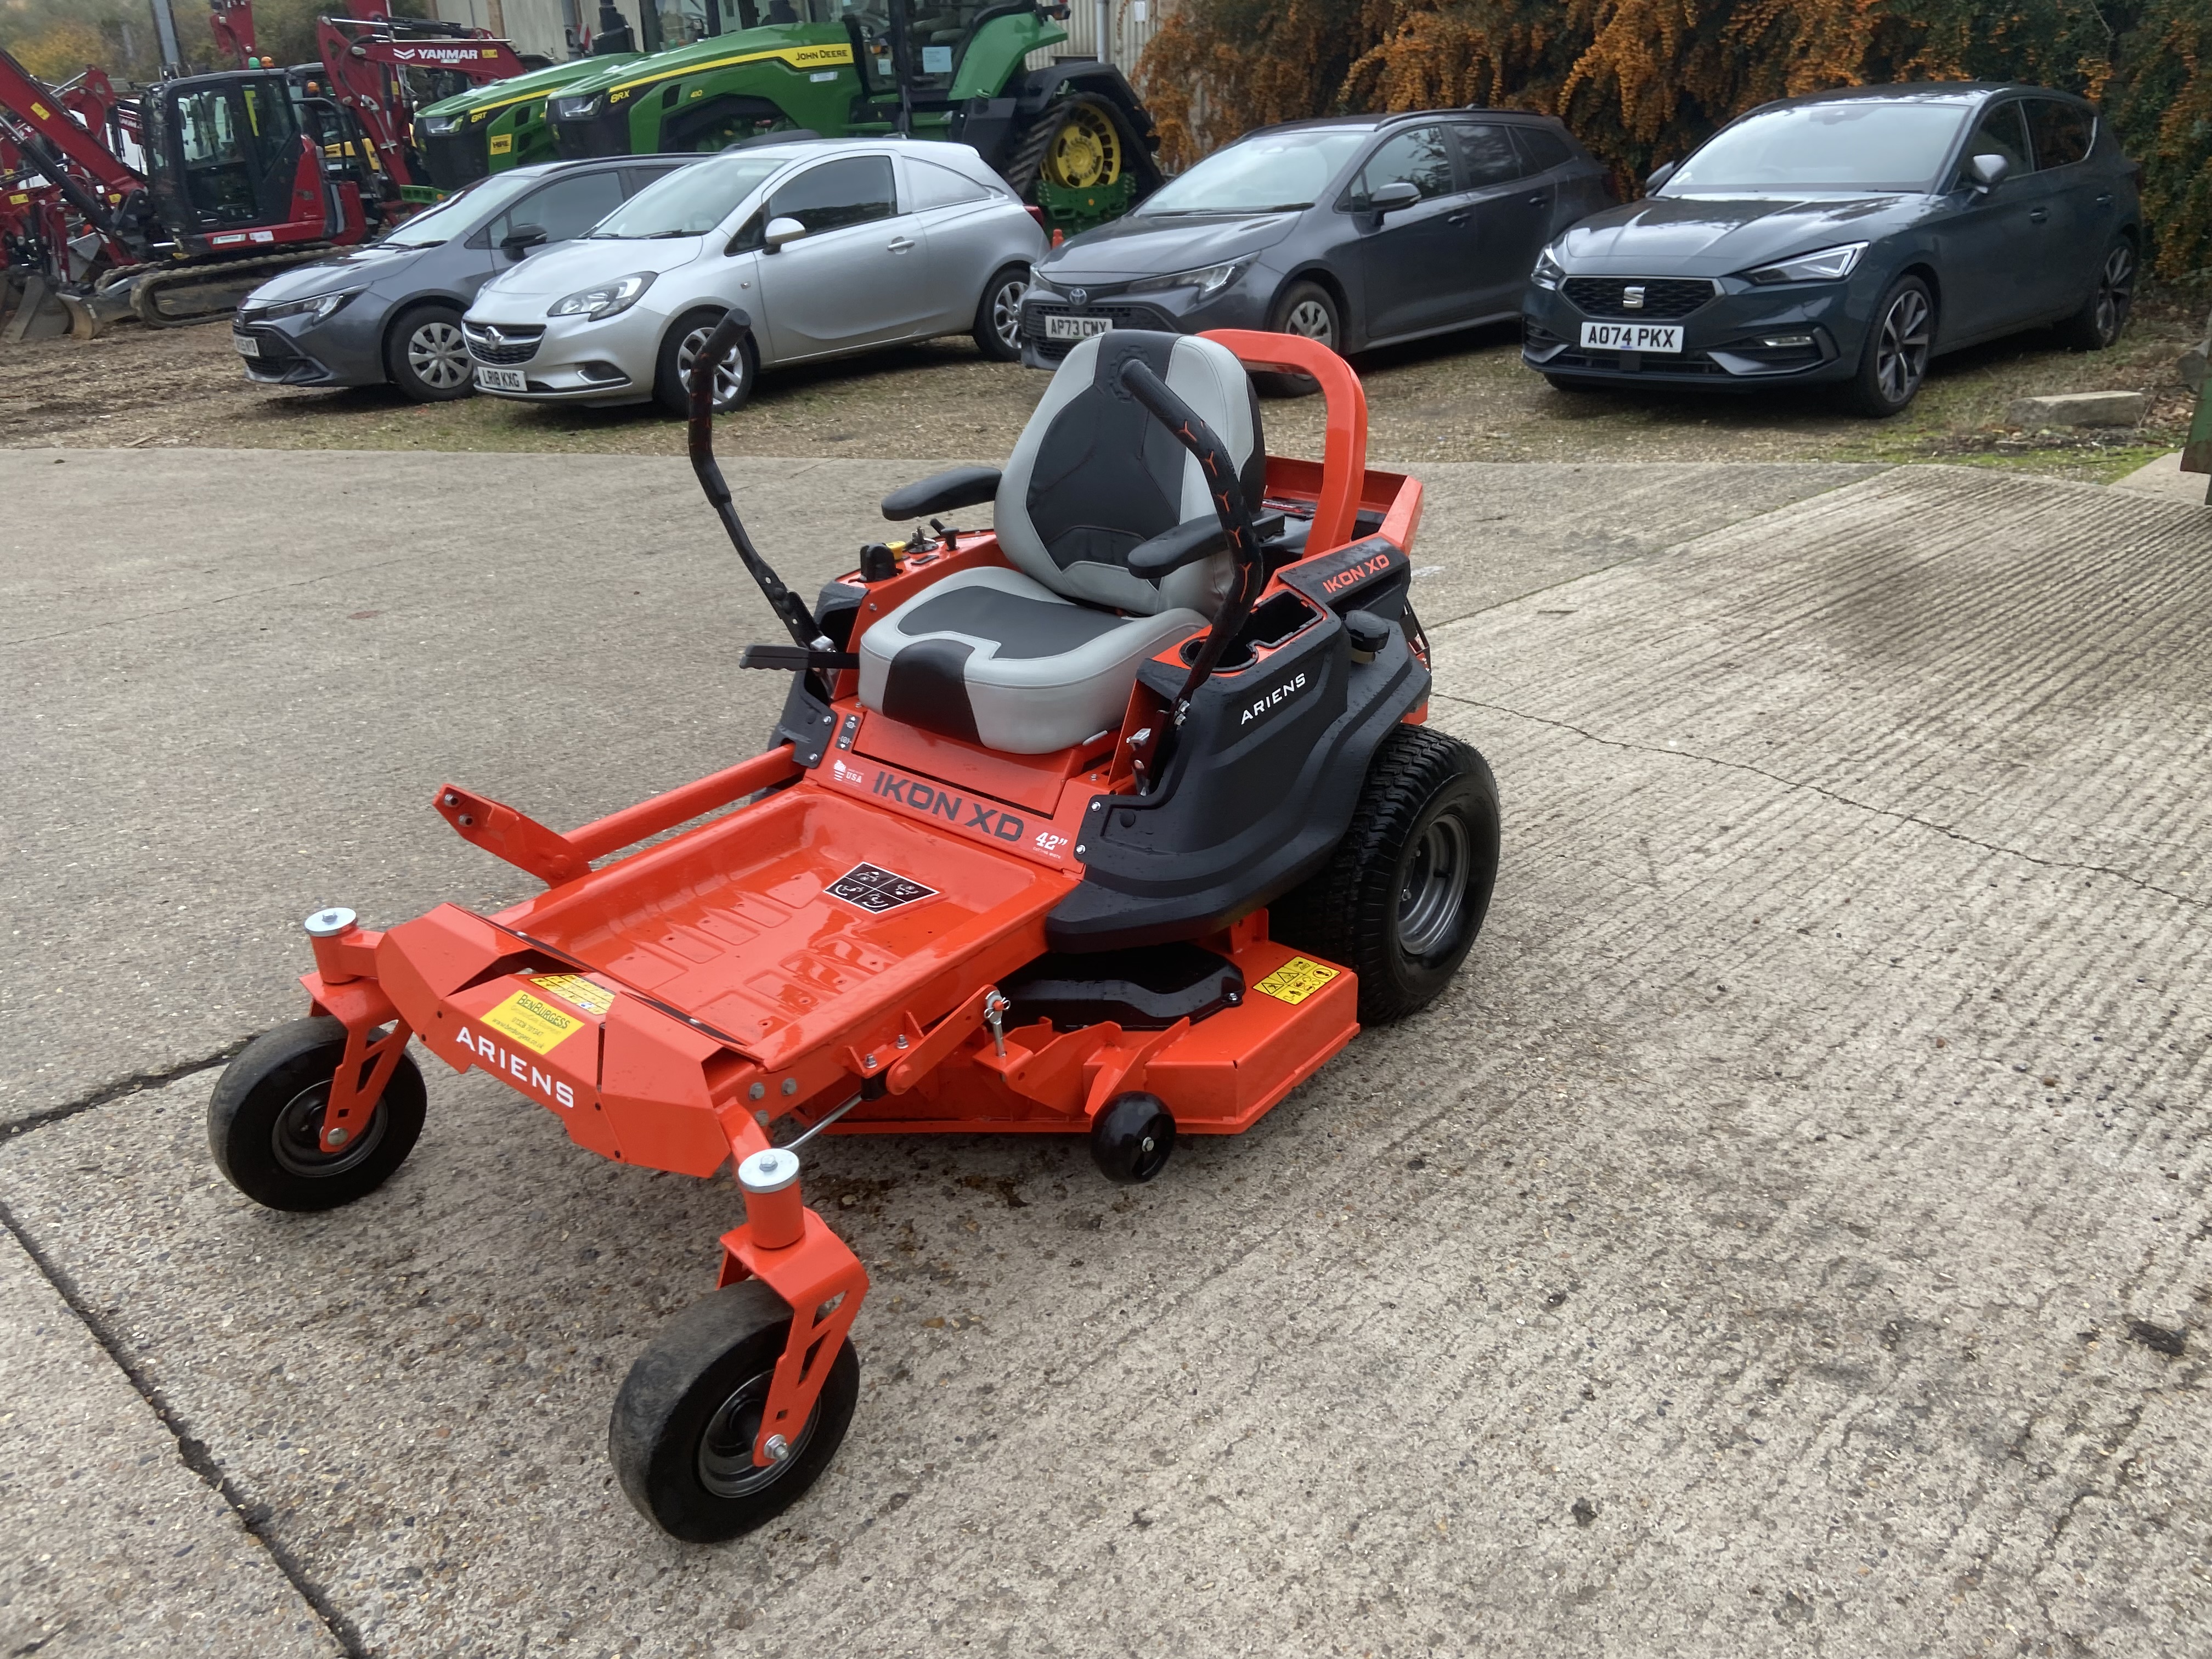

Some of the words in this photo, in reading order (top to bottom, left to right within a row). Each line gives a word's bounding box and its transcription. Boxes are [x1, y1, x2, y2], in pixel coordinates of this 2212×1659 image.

[417, 49, 478, 59] YANMAR
[796, 52, 819, 61] JOHN
[819, 50, 848, 58] DEERE
[1051, 319, 1080, 336] AP73
[1637, 328, 1675, 348] PKX
[482, 370, 501, 386] LR18
[500, 373, 520, 388] KXG
[1322, 565, 1366, 594] IKON
[1363, 554, 1390, 574] XD
[1241, 673, 1306, 725] ARIENS
[845, 771, 862, 783] USA
[873, 771, 962, 821] IKON
[964, 803, 1024, 842] XD
[456, 1026, 574, 1108] ARIENS
